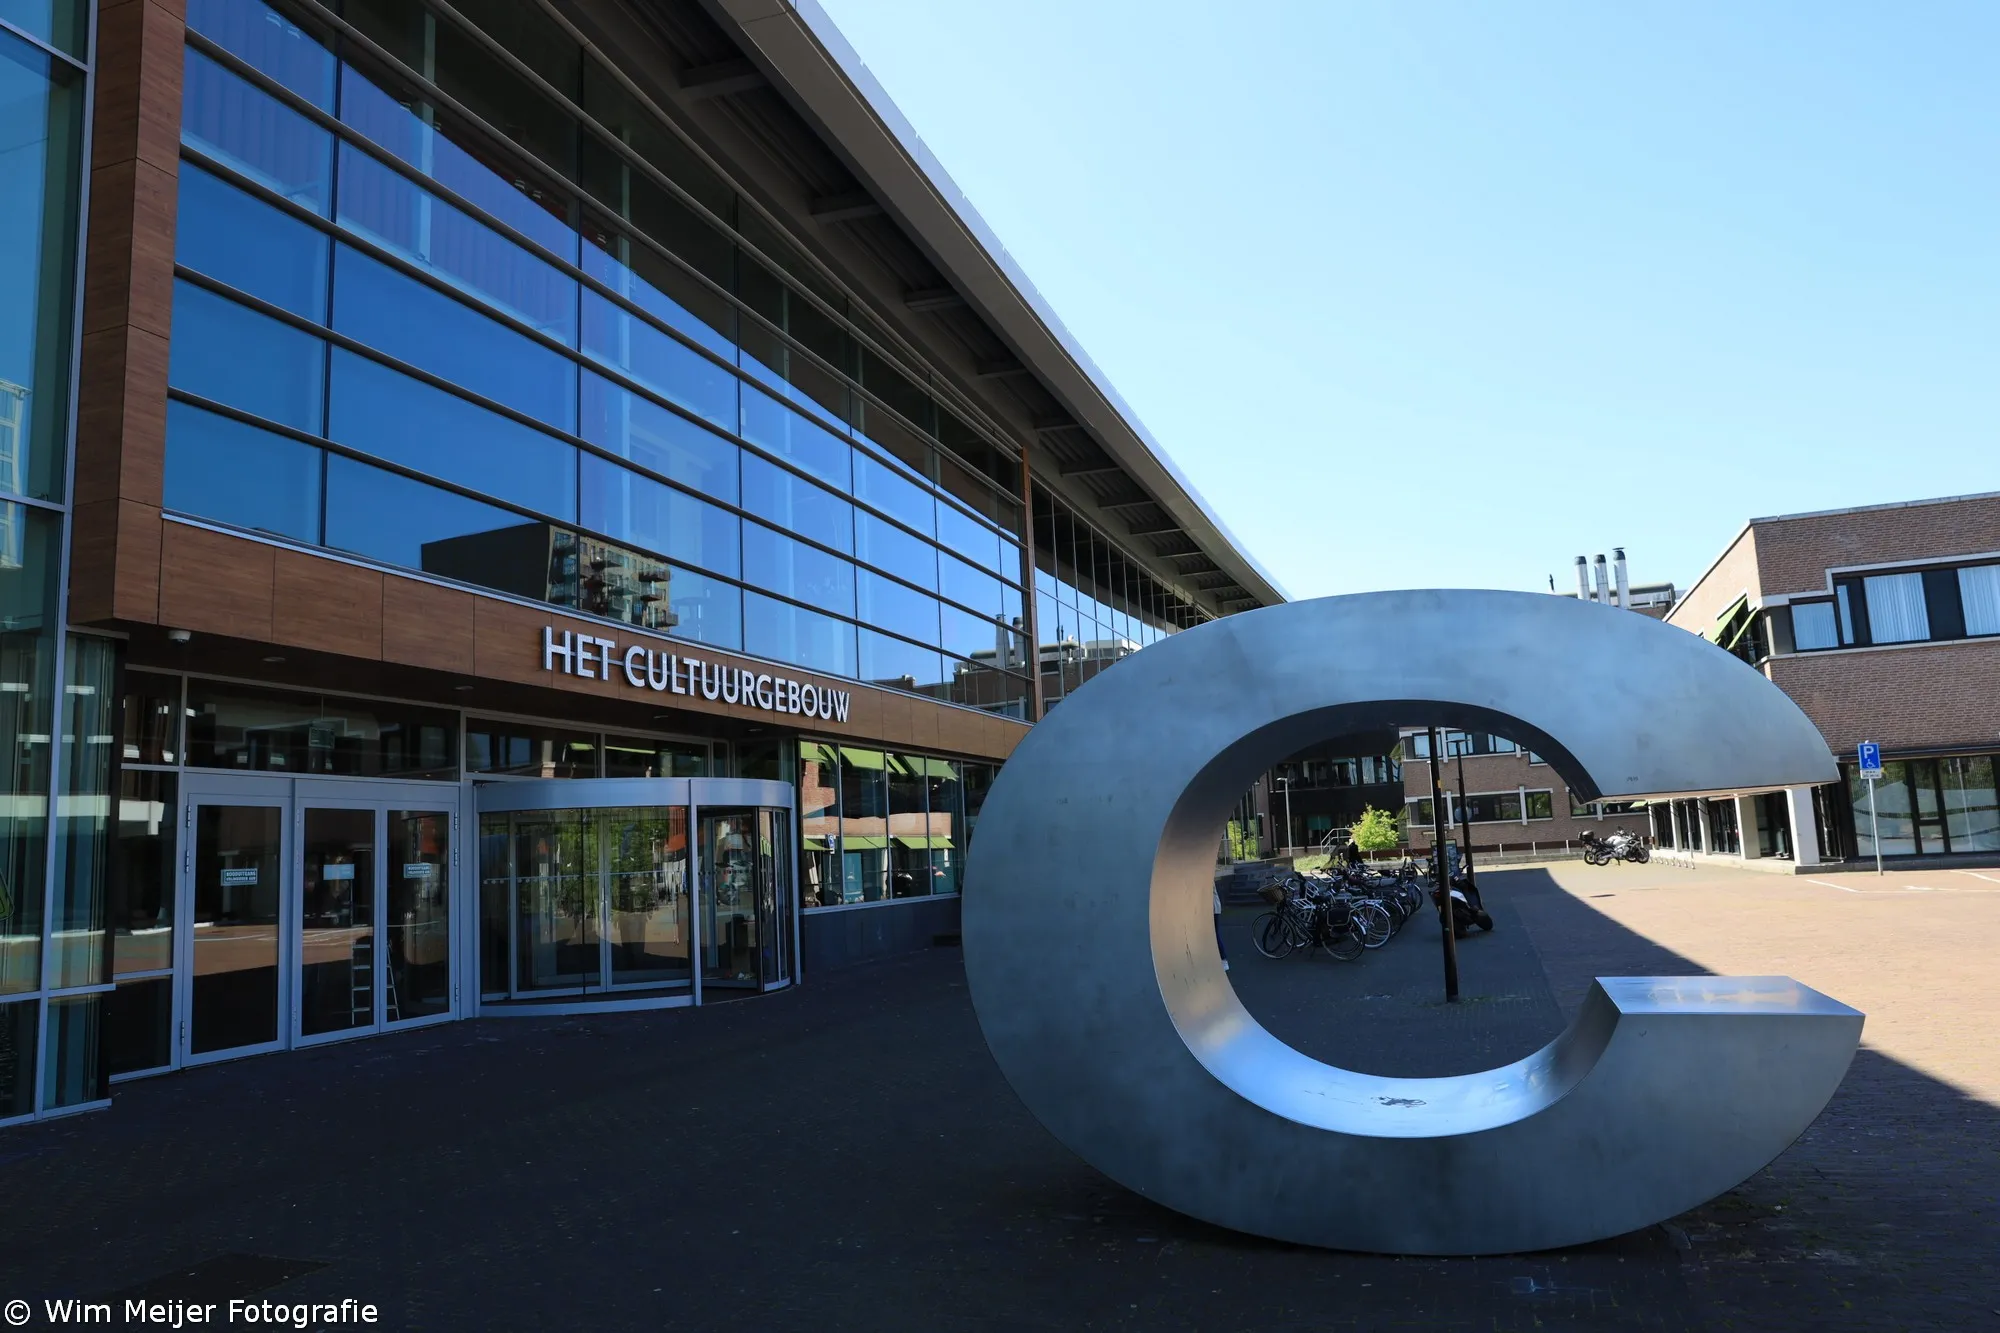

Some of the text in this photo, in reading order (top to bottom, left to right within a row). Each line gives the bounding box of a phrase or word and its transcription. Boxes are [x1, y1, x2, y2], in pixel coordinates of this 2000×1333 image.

[542, 625, 850, 723] HET CULTUURGEBOUW
[1863, 745, 1875, 759] P
